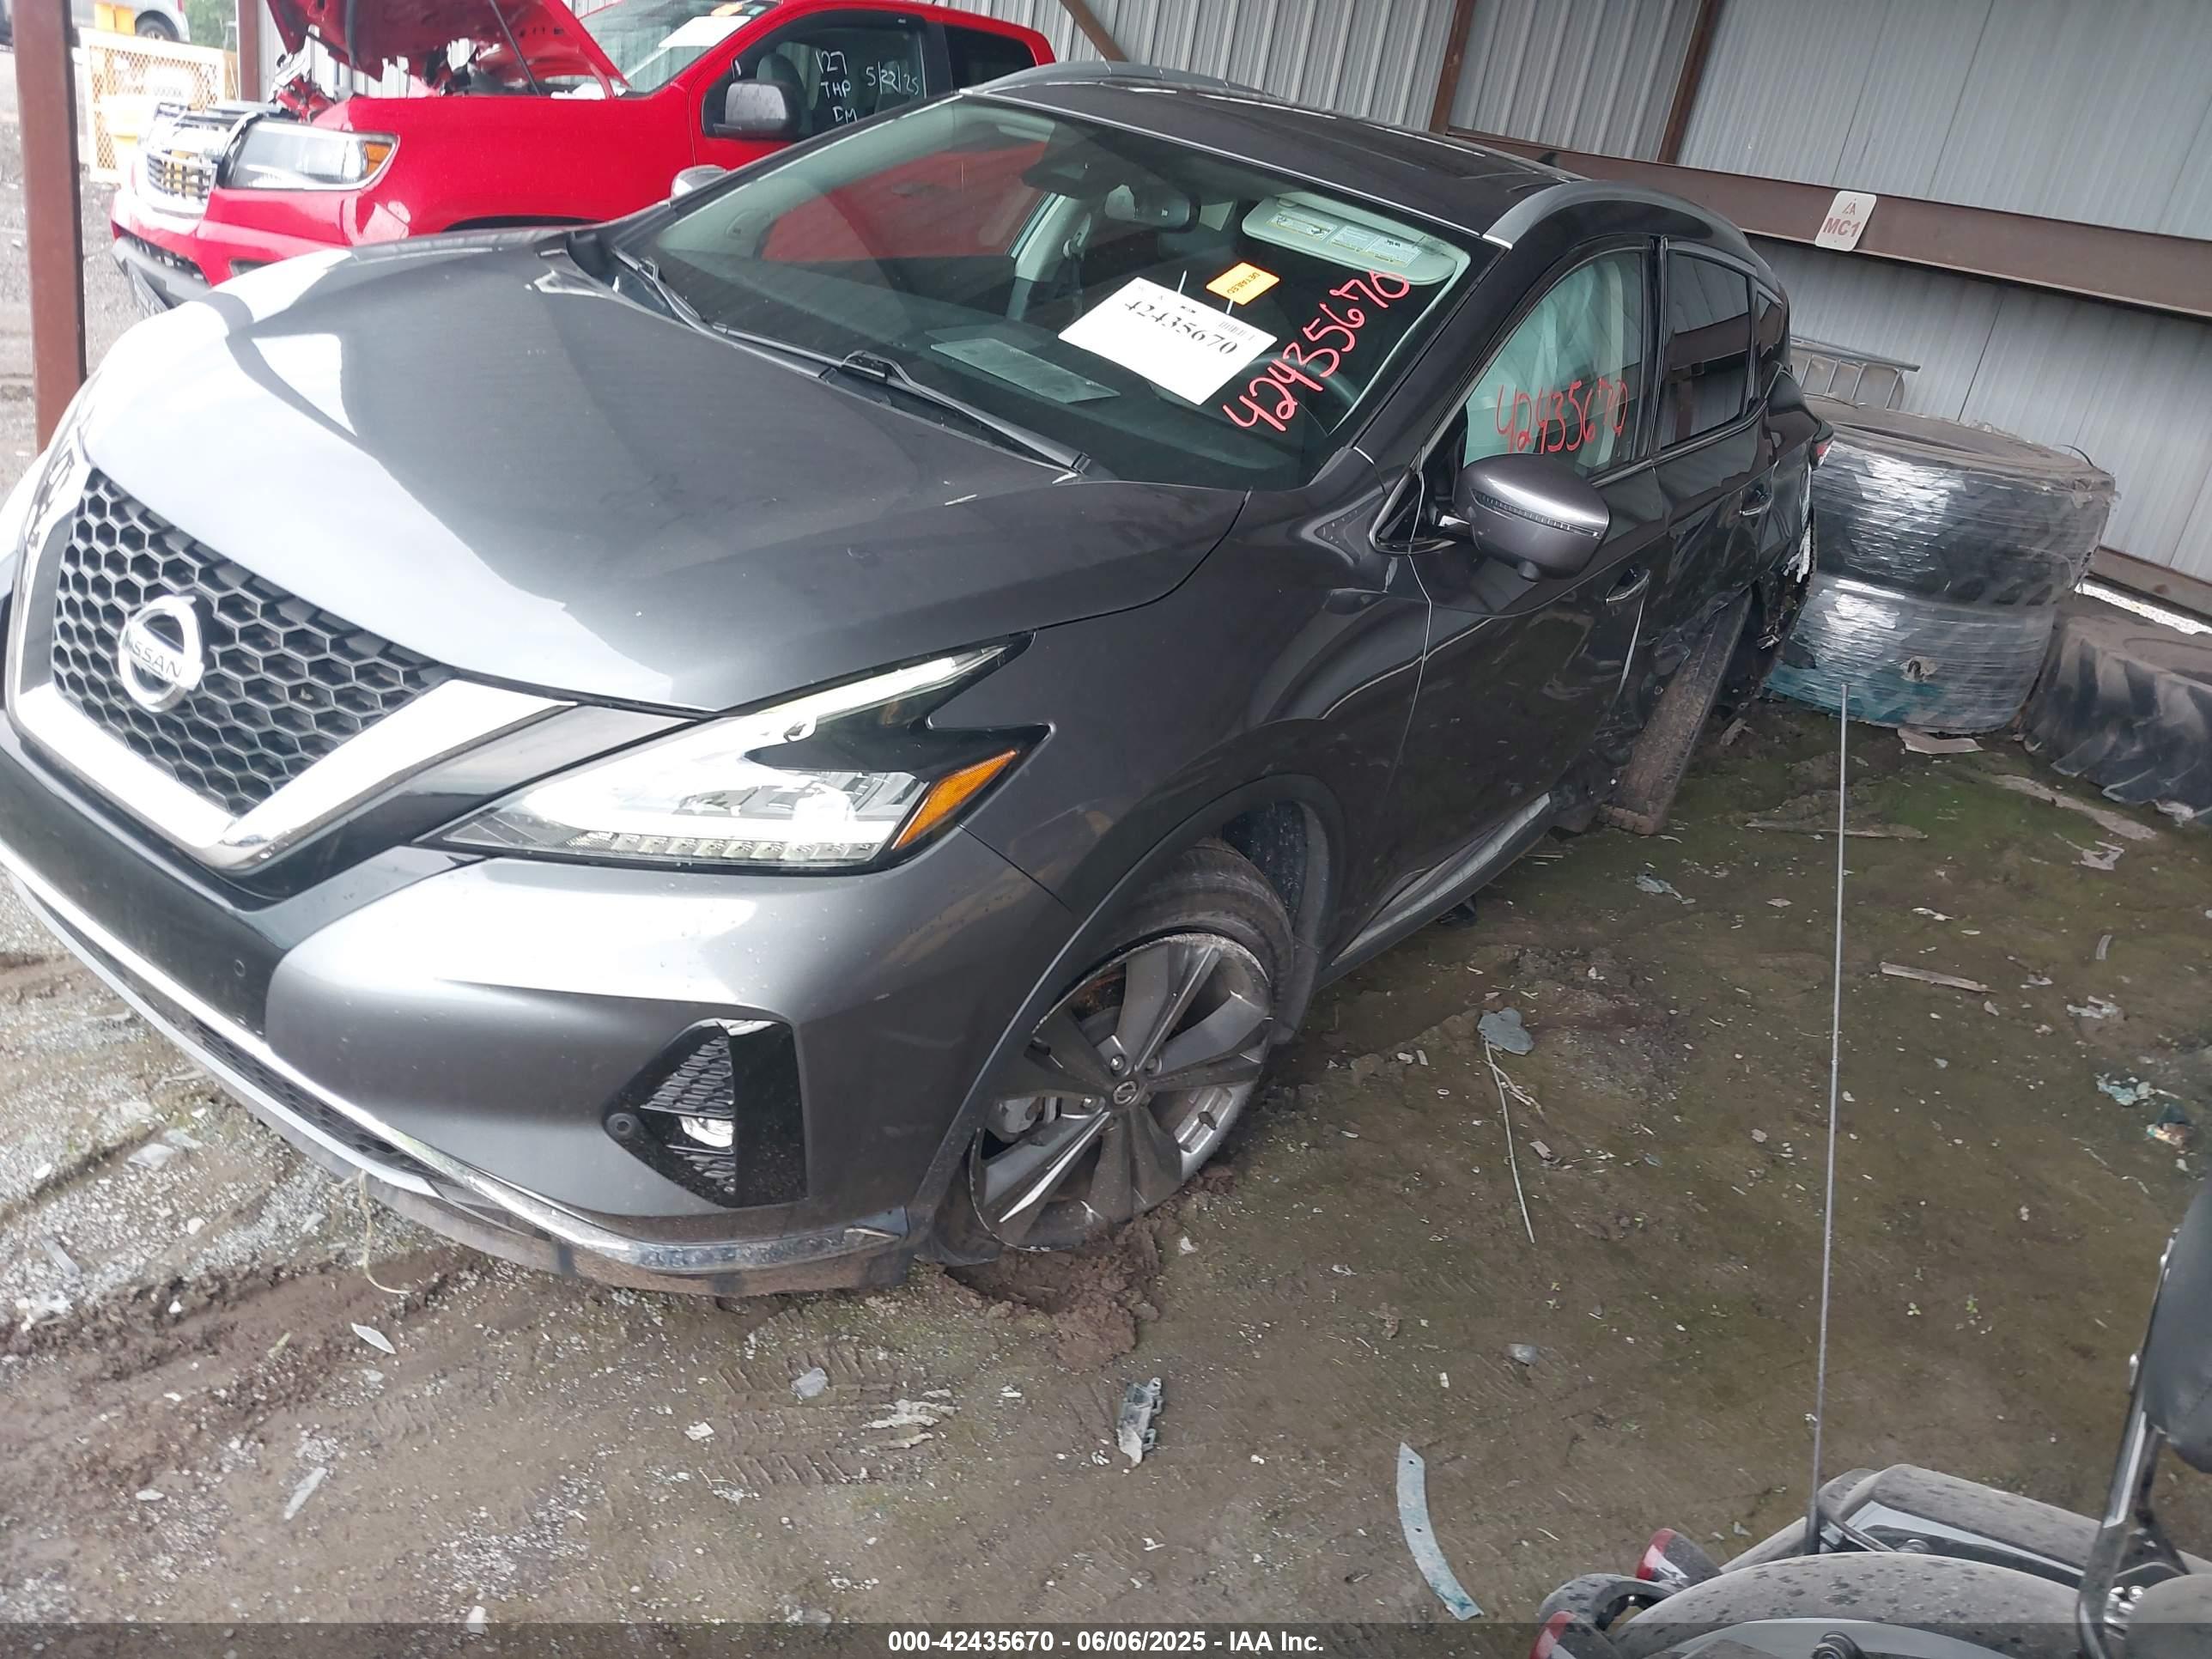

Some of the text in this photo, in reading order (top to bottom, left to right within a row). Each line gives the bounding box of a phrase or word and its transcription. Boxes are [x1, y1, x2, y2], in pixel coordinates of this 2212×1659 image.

[1822, 217, 1861, 237] MC1
[1124, 301, 1238, 354] 42435670
[1222, 268, 1411, 432] 42435670
[1497, 378, 1628, 453] 42435670
[121, 629, 183, 678] SSAN
